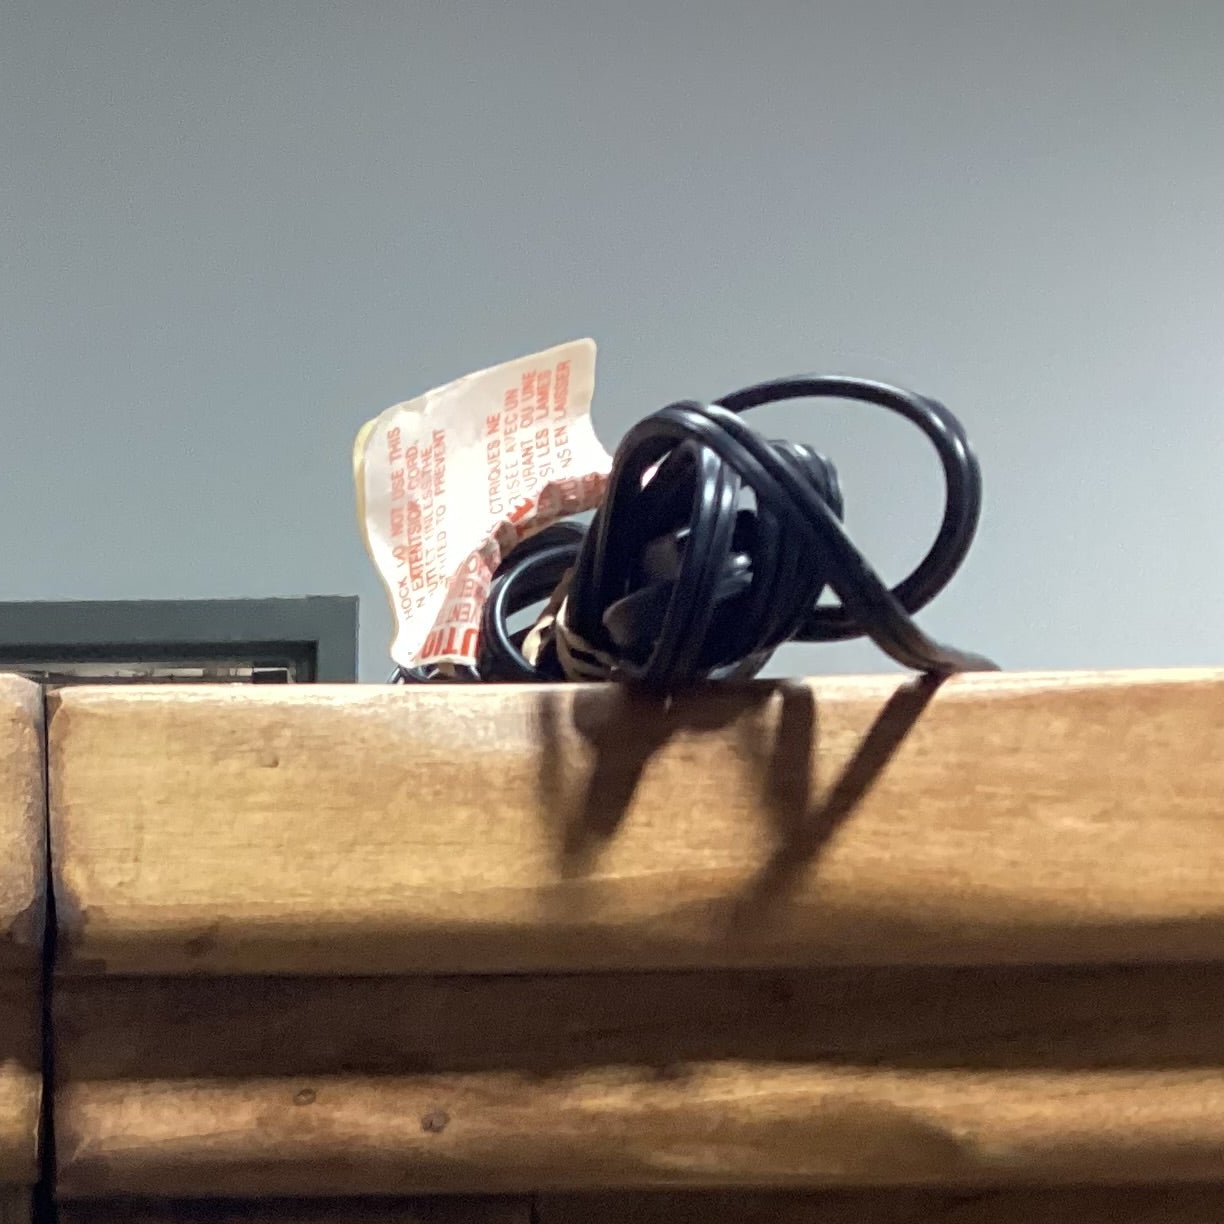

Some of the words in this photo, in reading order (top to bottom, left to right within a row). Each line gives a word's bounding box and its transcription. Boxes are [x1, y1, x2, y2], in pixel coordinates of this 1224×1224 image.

[504, 388, 518, 411] UN
[521, 370, 536, 402] UNE
[535, 369, 552, 420] LAMES
[553, 360, 571, 422] LAISSER
[486, 413, 500, 435] NE
[504, 413, 518, 452] AVEC
[520, 406, 534, 428] OU
[387, 427, 401, 464] THIS
[535, 428, 549, 457] LES
[554, 425, 568, 447] EN
[421, 446, 432, 478] THE
[432, 429, 445, 496] PREVENT
[487, 440, 503, 514] CTRIQUES
[538, 462, 554, 477] SI
[391, 468, 404, 501] USE
[390, 507, 403, 536] NOT
[436, 505, 446, 526] TO
[398, 576, 413, 620] HOCK
